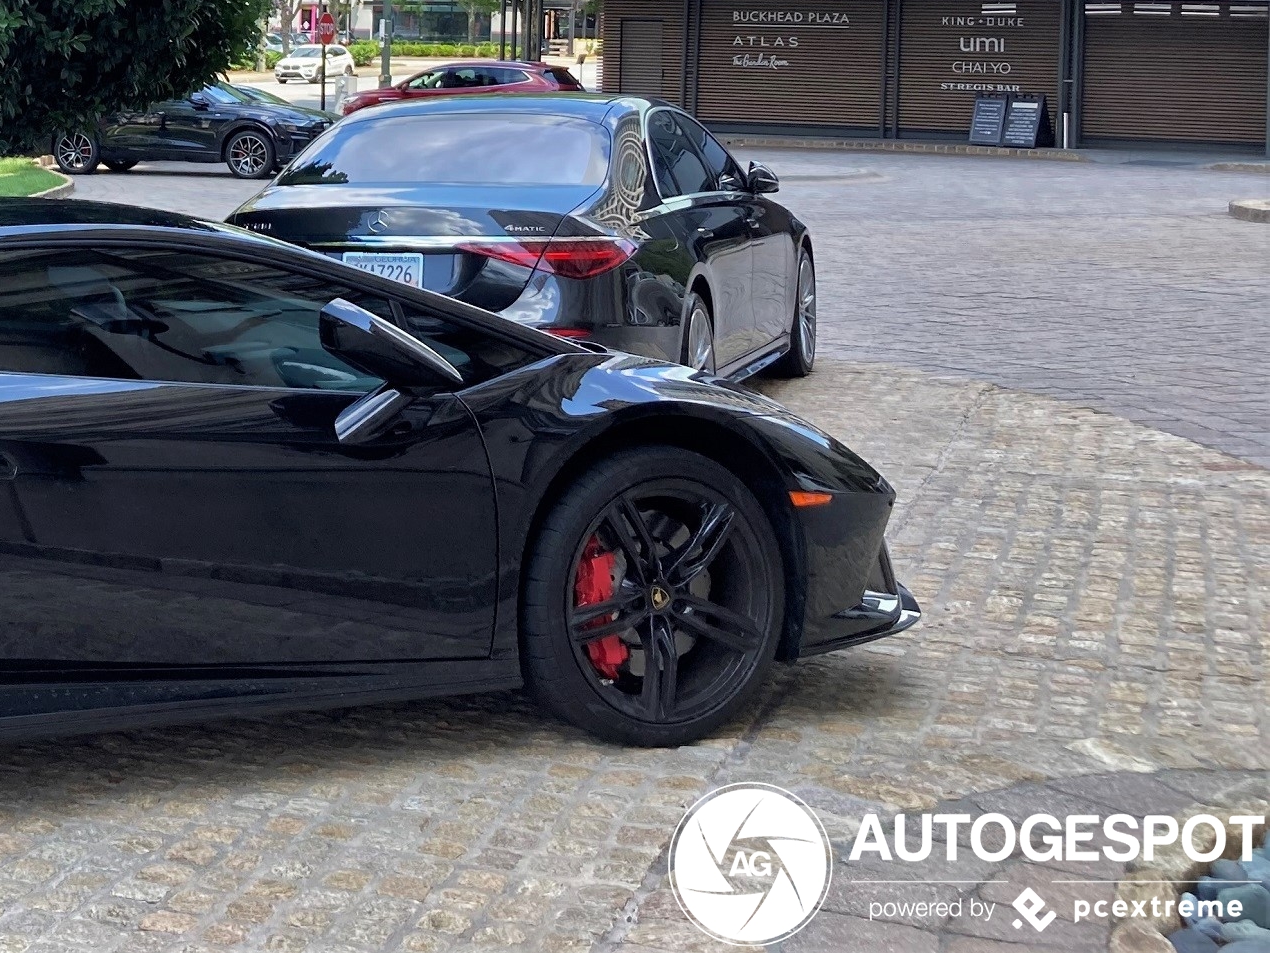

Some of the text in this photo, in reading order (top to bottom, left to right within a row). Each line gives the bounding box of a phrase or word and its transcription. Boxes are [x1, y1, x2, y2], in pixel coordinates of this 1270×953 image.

[732, 11, 850, 23] BUCKHEAD PLAZA
[942, 17, 1024, 27] KING DUKE
[320, 23, 334, 35] STOP
[732, 36, 799, 47] ATLAS
[959, 37, 1005, 52] umi
[997, 84, 1020, 92] BAR
[504, 224, 546, 232] 4MATIC
[356, 264, 412, 284] 7226
